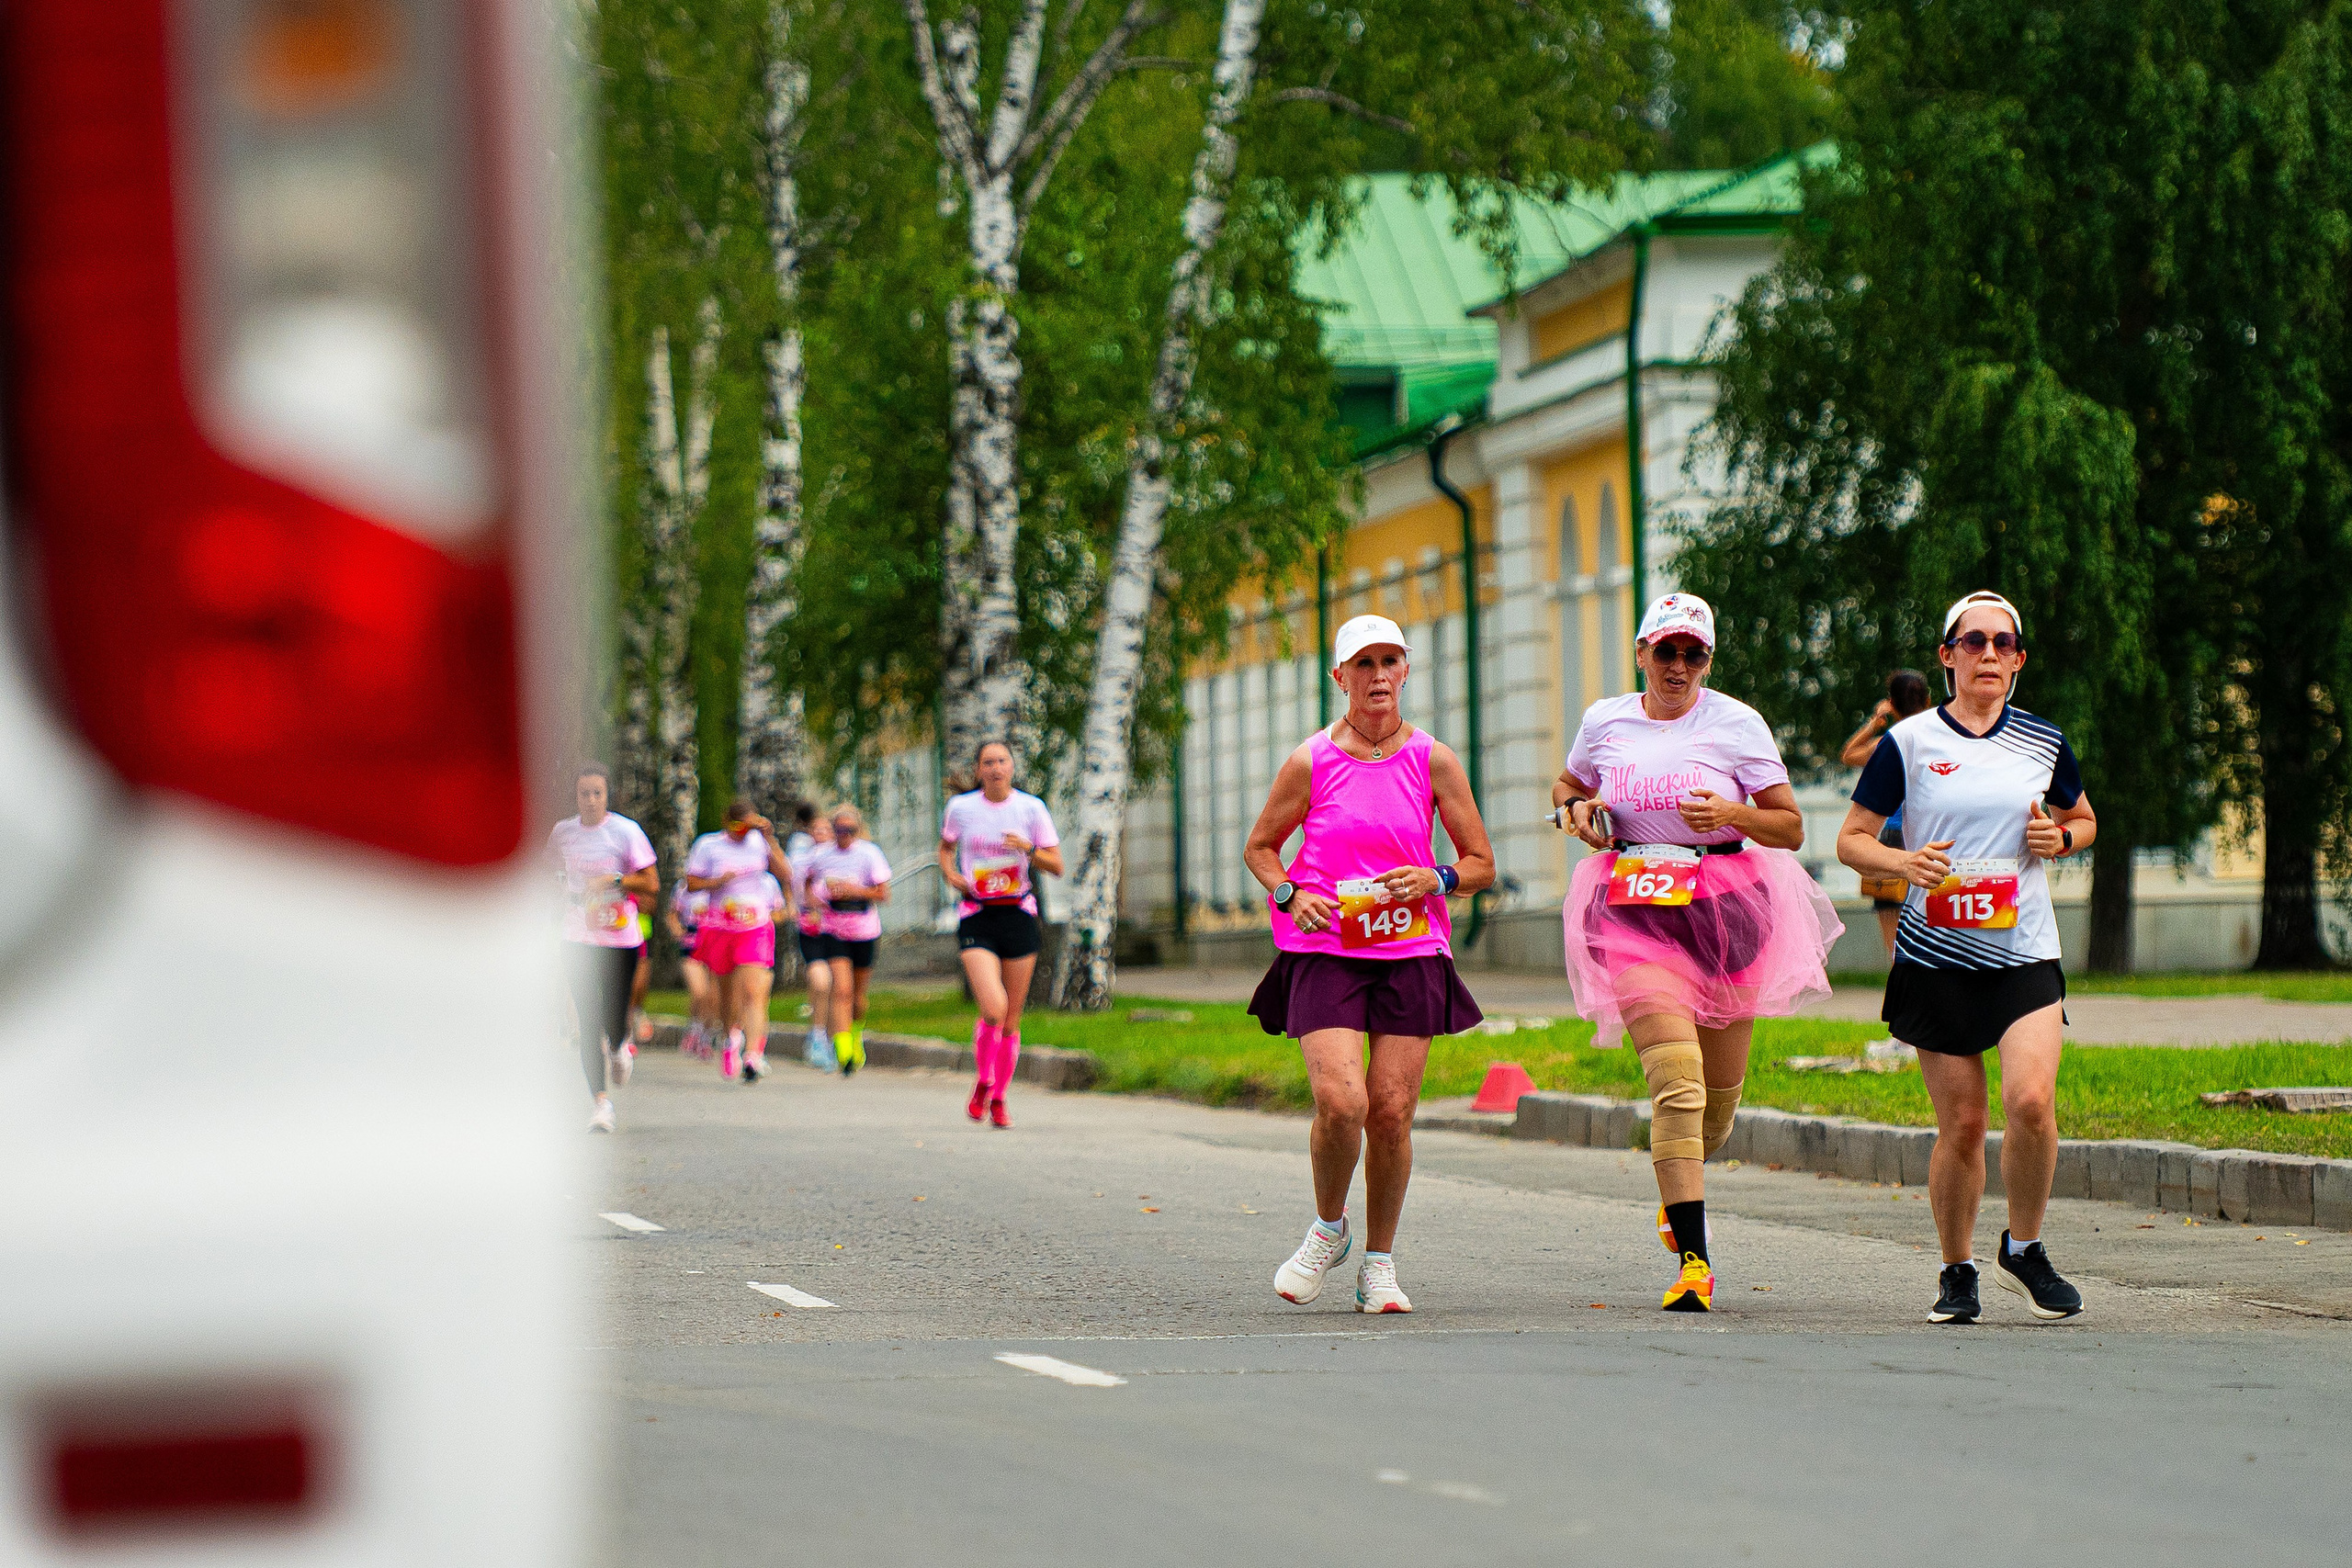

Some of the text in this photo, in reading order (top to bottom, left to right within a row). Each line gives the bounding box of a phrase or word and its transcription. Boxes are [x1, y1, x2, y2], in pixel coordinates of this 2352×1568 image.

[1610, 763, 1707, 805] Женский
[1625, 873, 1675, 898] 162
[1948, 894, 1995, 920] 113
[1357, 907, 1413, 938] 149
